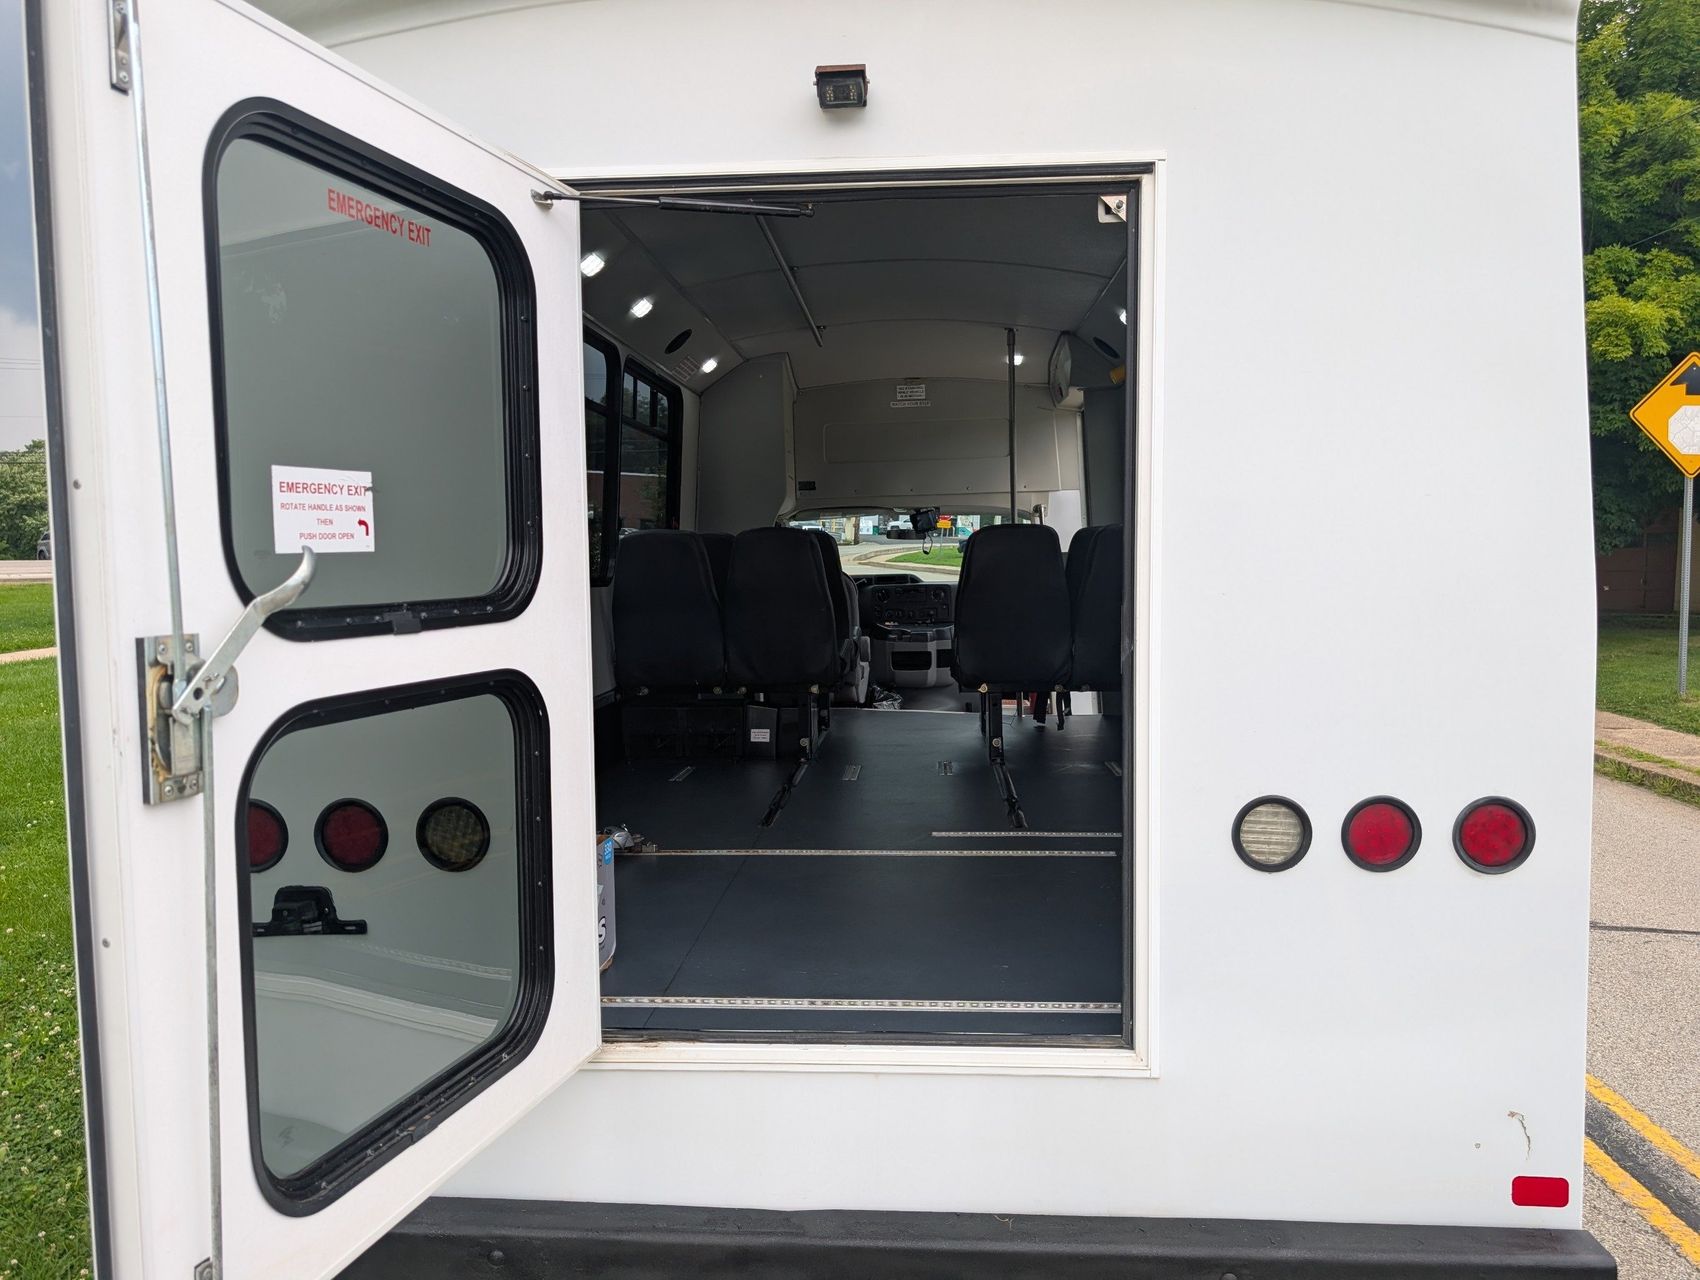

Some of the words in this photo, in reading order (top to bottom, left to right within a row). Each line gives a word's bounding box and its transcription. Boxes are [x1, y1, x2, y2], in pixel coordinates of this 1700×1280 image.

[327, 188, 405, 237] EMERGENCY
[407, 221, 432, 247] EXIT
[279, 481, 345, 495] EMERGENCY
[347, 485, 368, 496] EXIT
[280, 502, 306, 511] ROTATE
[308, 503, 333, 511] HANDLE
[335, 504, 343, 512] AS
[345, 504, 366, 512] SHOWN
[316, 518, 333, 526] THEN
[299, 532, 317, 540] PUSH
[318, 532, 337, 540] DOOR
[338, 532, 355, 540] OPEN
